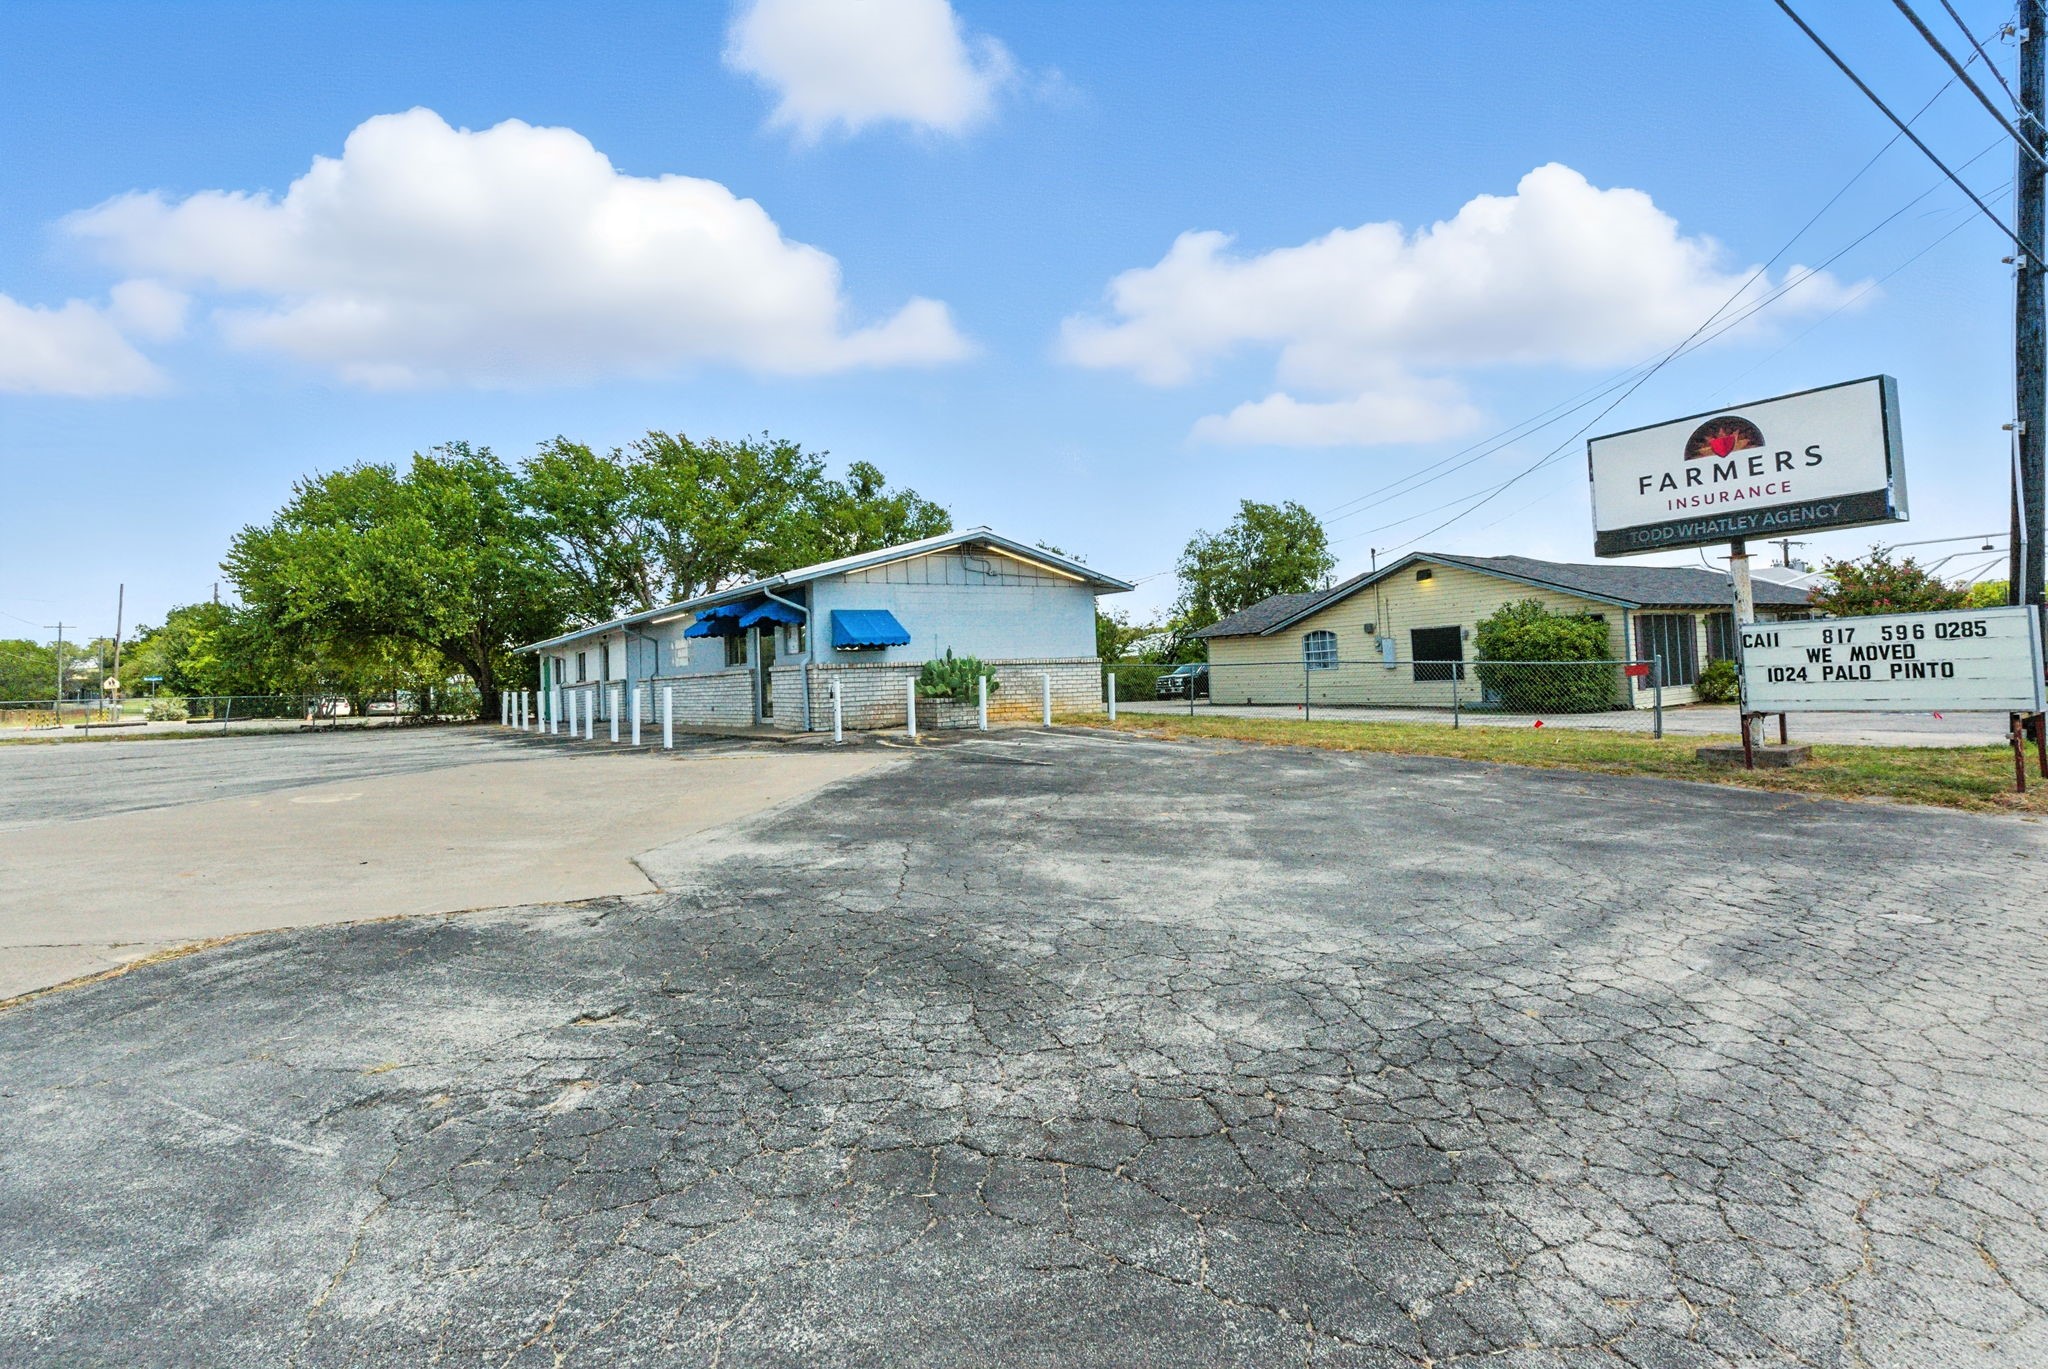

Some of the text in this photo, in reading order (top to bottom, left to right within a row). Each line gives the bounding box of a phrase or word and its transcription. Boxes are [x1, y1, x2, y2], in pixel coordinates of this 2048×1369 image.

[1639, 445, 1823, 495] FARMERS
[1668, 480, 1792, 511] INSURANCE
[1630, 503, 1842, 544] TODD WHATLEY AGENCY
[1822, 628, 1855, 644] 817
[1881, 624, 1925, 641] 596
[1935, 620, 1987, 639] 0285
[1806, 643, 1916, 663] WE MOVED
[1768, 662, 1954, 682] 1024 PALO PINTO
